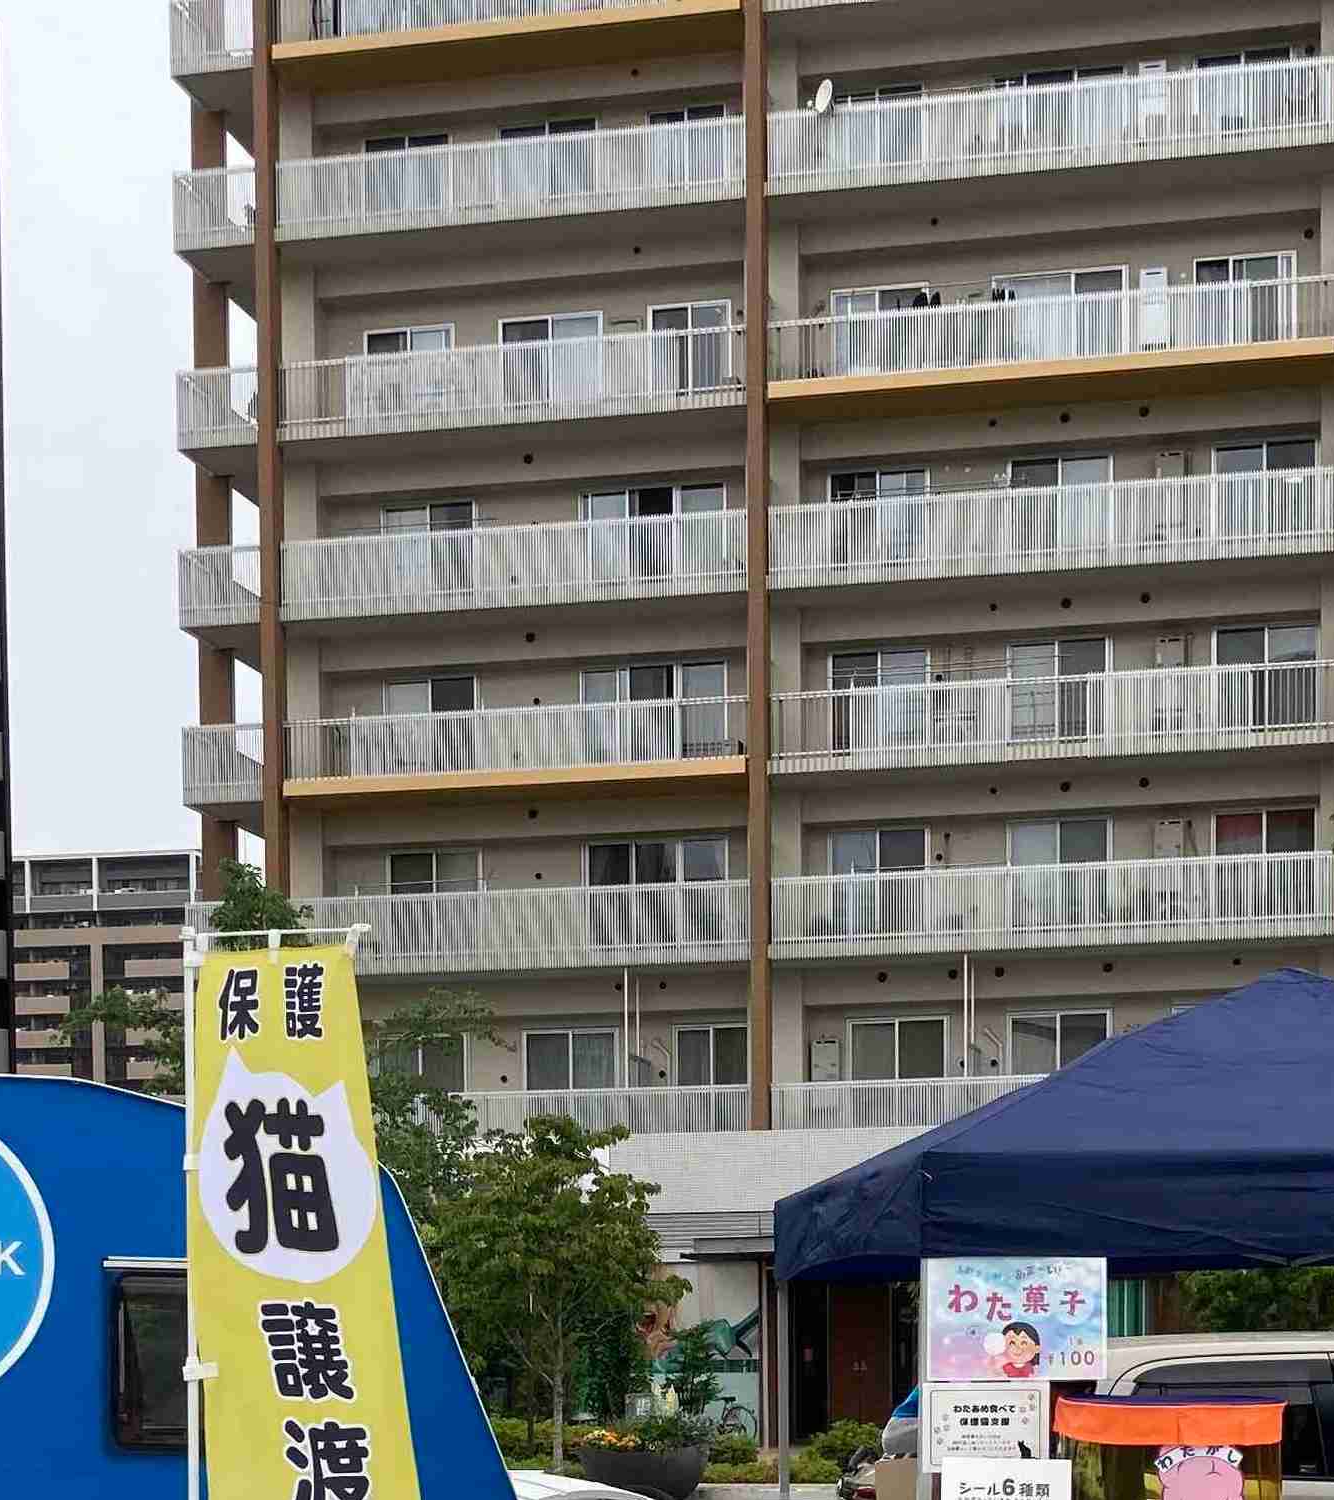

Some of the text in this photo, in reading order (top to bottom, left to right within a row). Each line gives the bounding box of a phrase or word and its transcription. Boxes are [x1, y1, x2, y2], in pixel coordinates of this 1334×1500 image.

[218, 963, 324, 1041] 保護
[224, 1098, 340, 1254] 猫
[948, 1283, 1086, 1321] わた菓子
[1155, 1446, 1238, 1470] わたがし
[959, 1478, 1050, 1497] シール6種類
